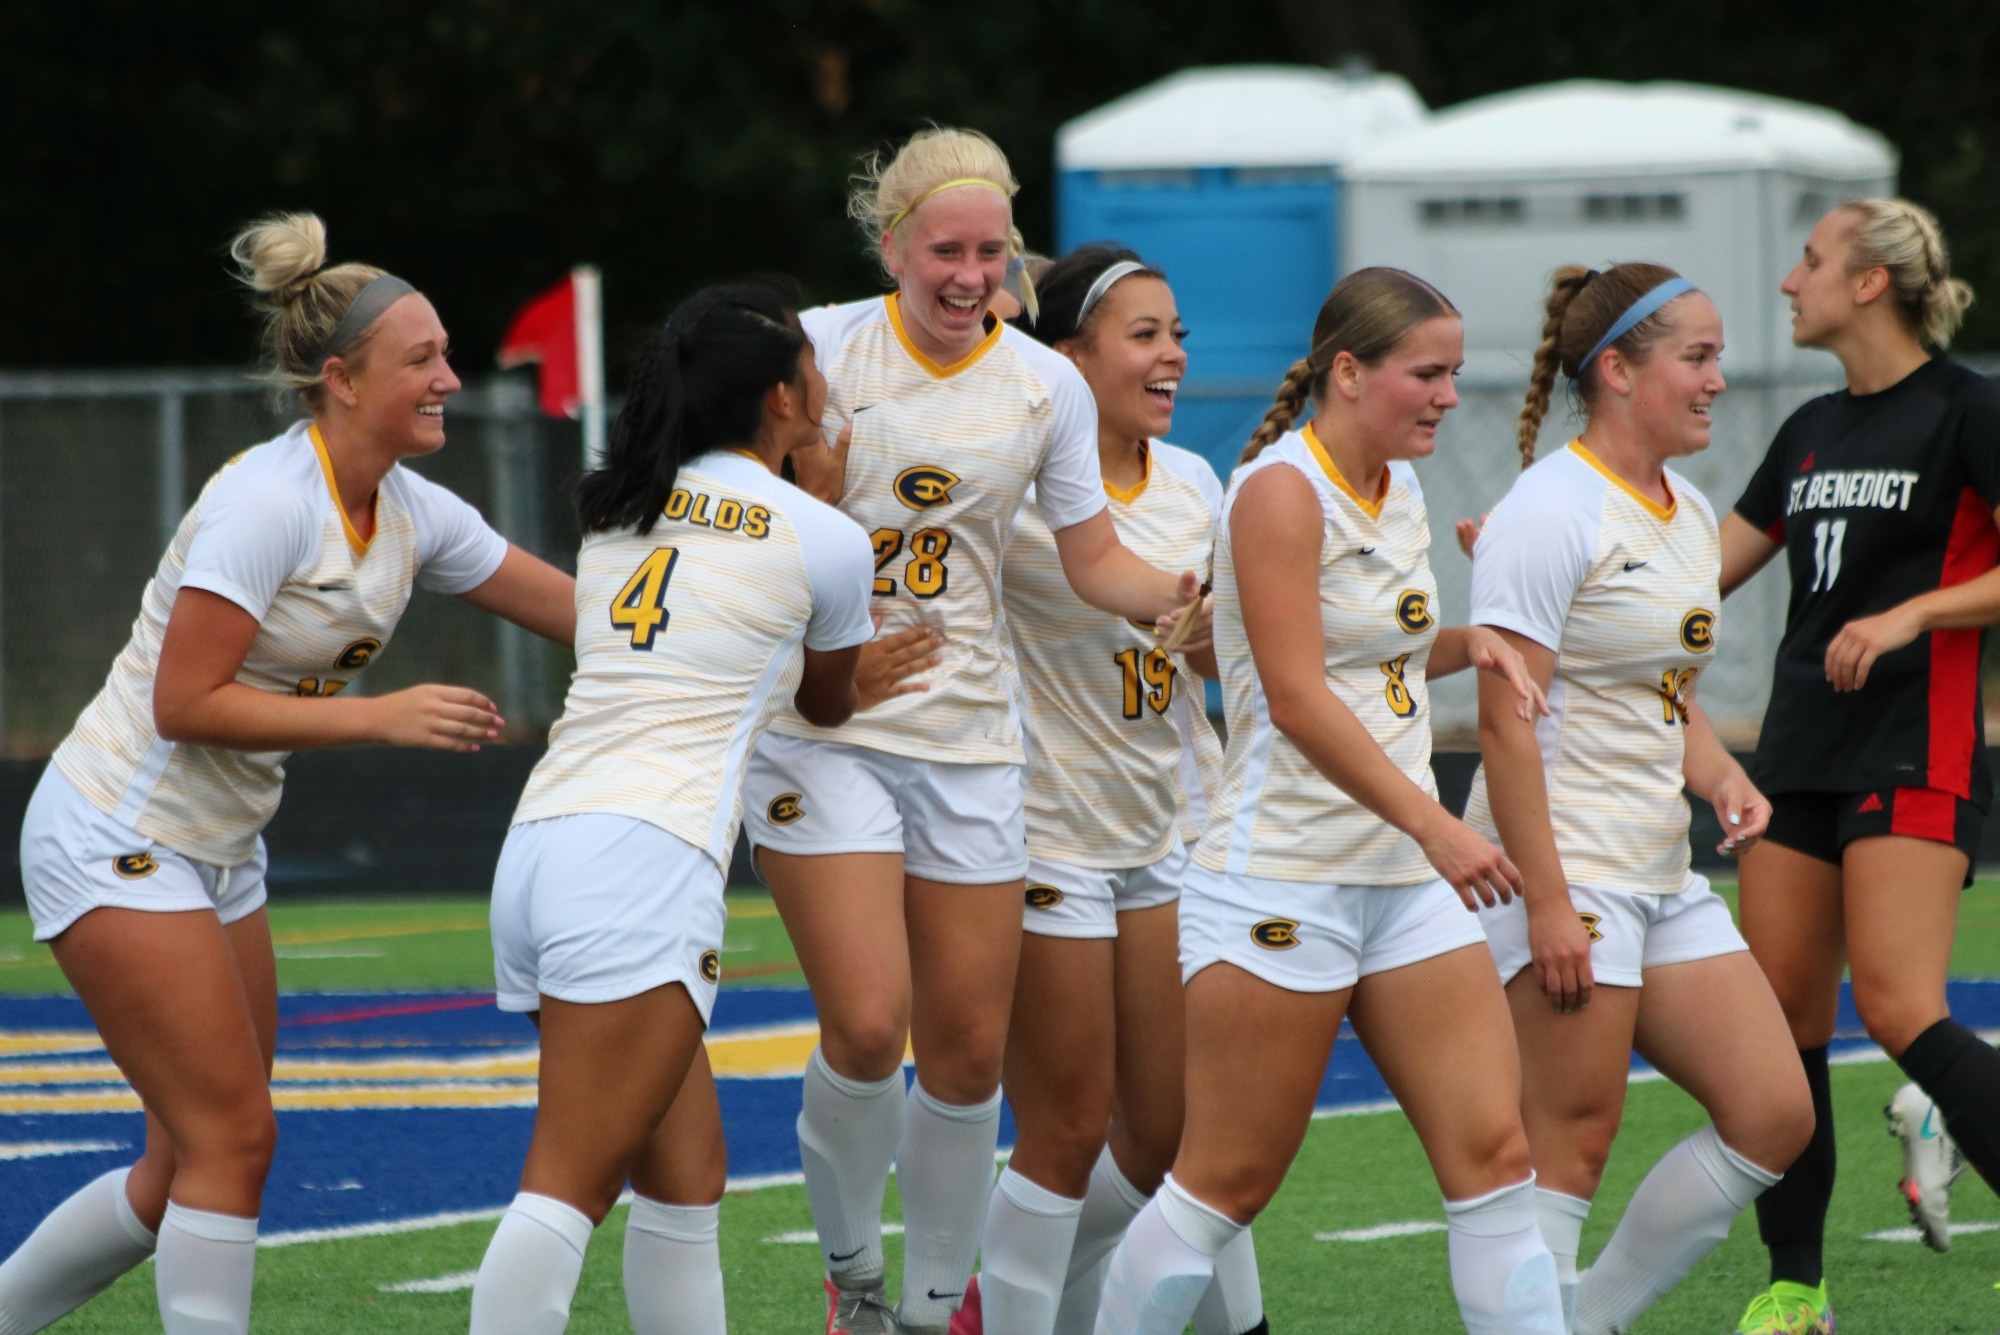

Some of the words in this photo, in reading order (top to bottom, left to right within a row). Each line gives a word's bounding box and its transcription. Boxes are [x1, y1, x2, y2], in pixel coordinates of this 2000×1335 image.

[1787, 478, 1807, 516] ST.
[1805, 471, 1919, 511] BENEDICT
[870, 527, 952, 600] 28
[1812, 519, 1848, 592] 11
[610, 547, 679, 651] 4
[1114, 647, 1178, 720] 19
[1380, 653, 1418, 719] 8
